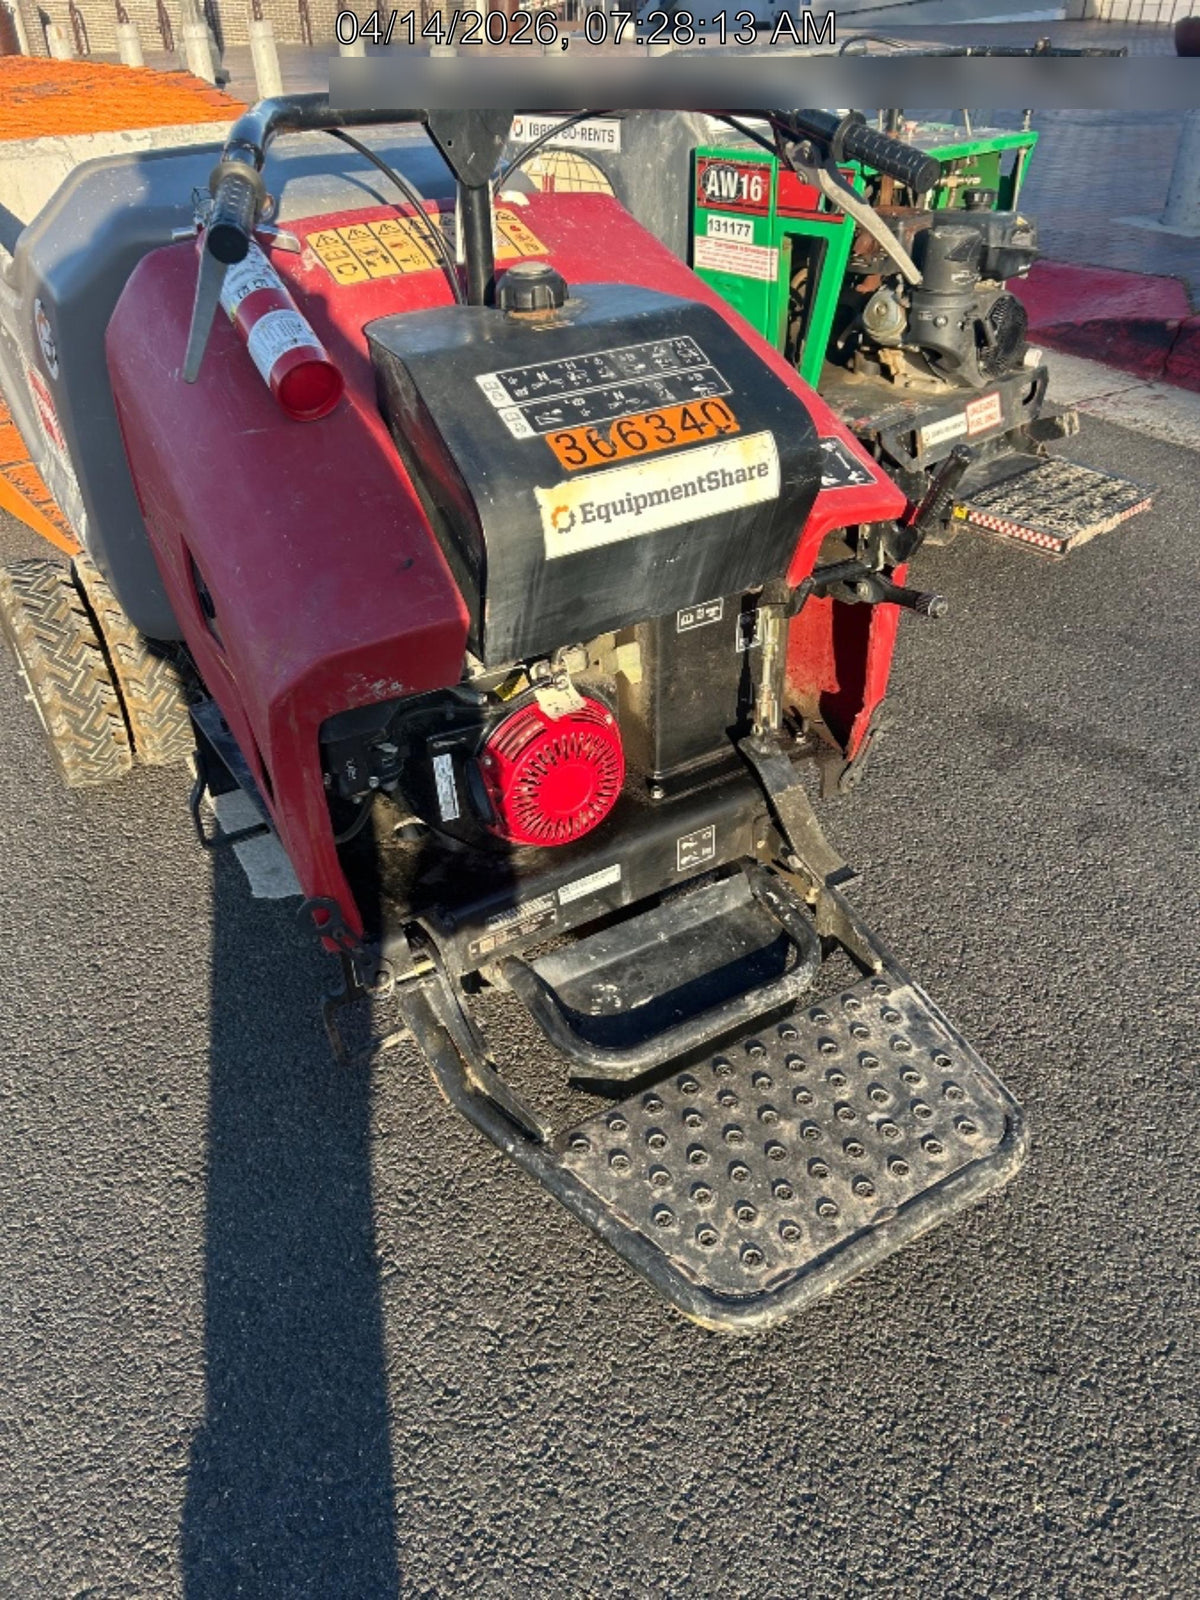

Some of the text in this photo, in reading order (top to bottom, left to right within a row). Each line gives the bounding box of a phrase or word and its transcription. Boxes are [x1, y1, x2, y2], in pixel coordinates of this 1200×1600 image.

[706, 169, 762, 202] AW16
[708, 218, 751, 237] 131177
[554, 400, 733, 466] 366340
[579, 461, 769, 525] EquipmentShare
